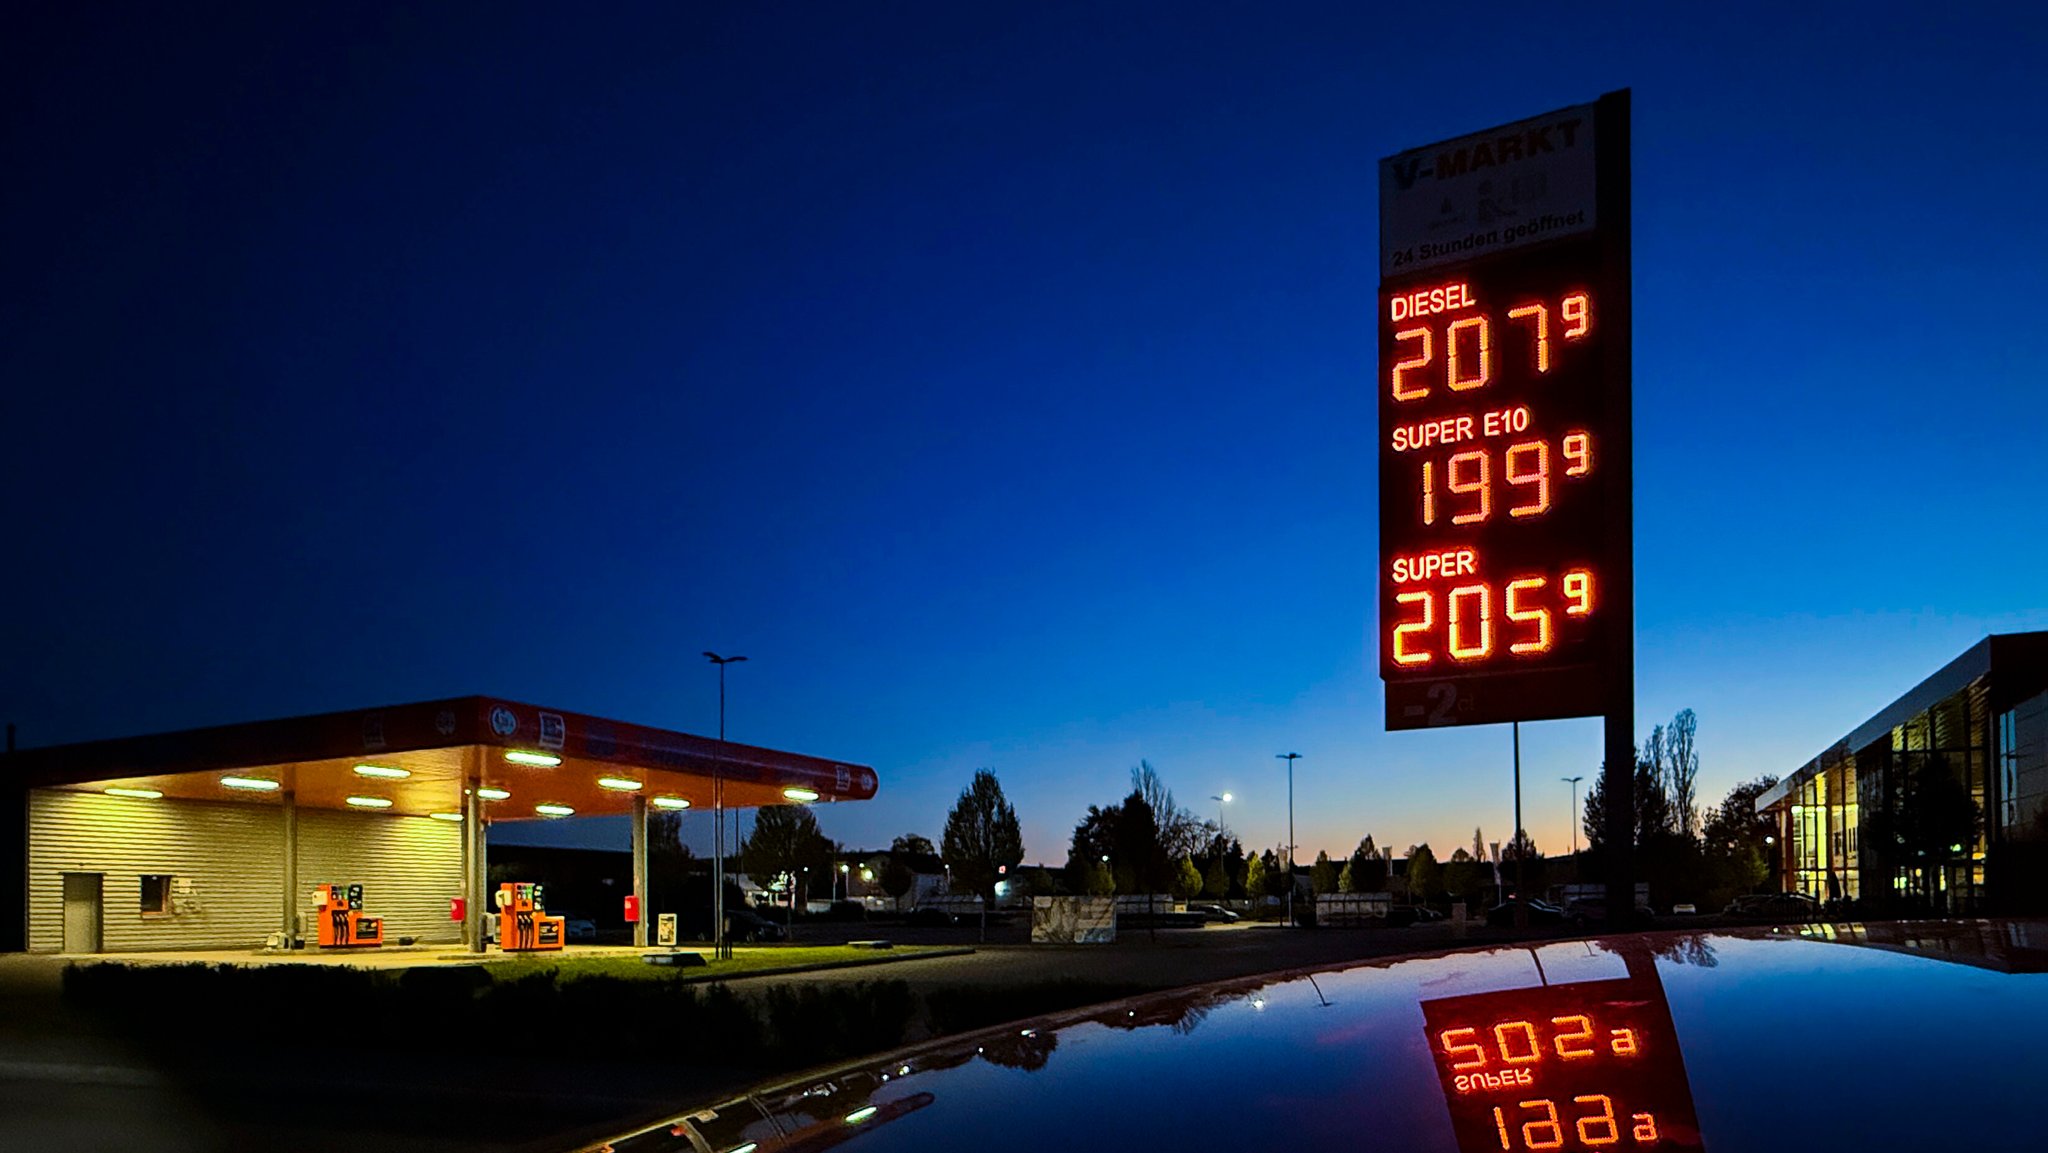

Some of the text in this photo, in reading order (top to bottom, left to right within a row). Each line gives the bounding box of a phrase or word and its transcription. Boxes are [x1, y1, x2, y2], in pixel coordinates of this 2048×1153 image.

[1393, 118, 1582, 190] V-MARKT
[1393, 209, 1585, 267] 24 Stunden geöffnet
[1391, 283, 1477, 322] DIESEL
[1391, 406, 1529, 452] SUPER E10
[1391, 550, 1476, 584] SUPER
